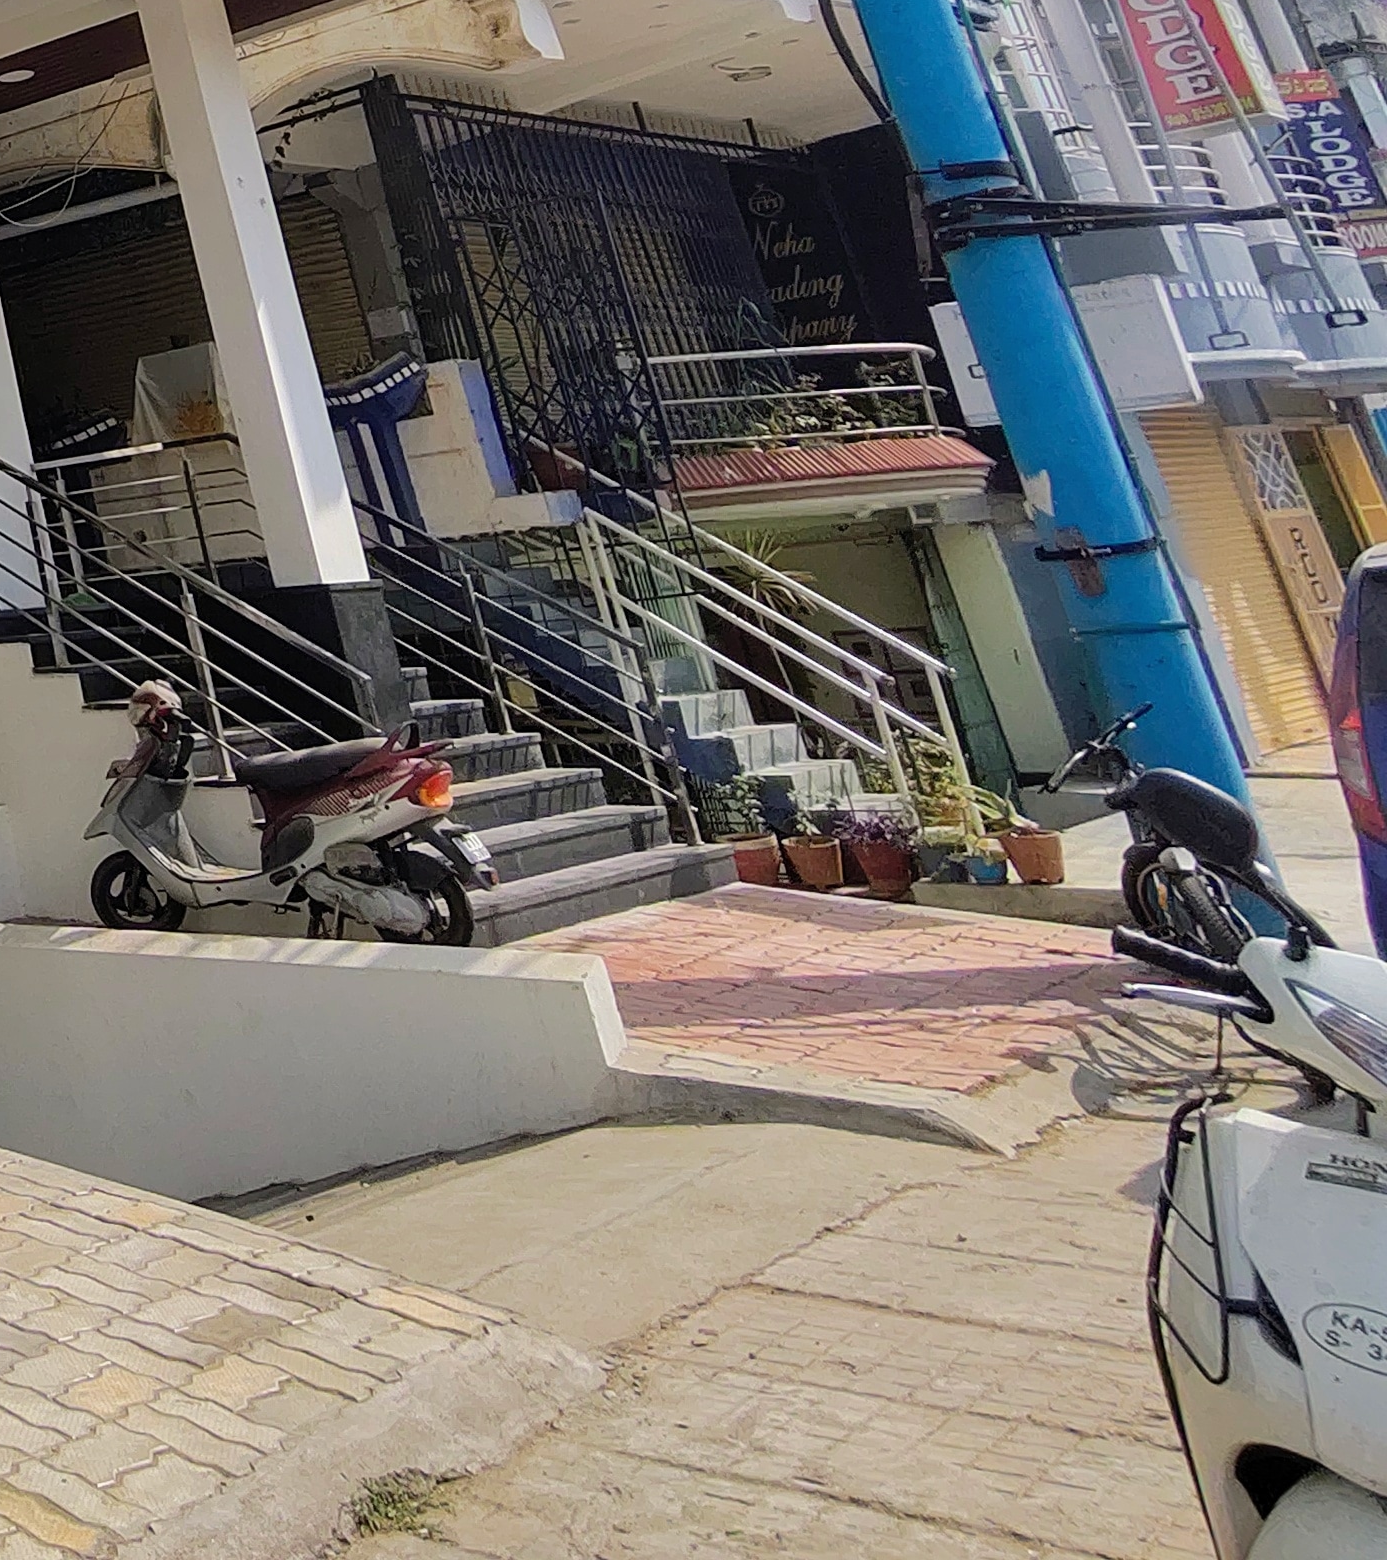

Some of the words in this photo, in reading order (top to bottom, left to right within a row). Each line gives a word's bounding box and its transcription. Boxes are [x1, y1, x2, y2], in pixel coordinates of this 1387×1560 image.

[1285, 100, 1344, 119] S.A
[1304, 120, 1375, 207] LODGE
[1336, 220, 1387, 250] ROOM
[770, 264, 844, 309] ading
[1366, 1343, 1387, 1362] 3
